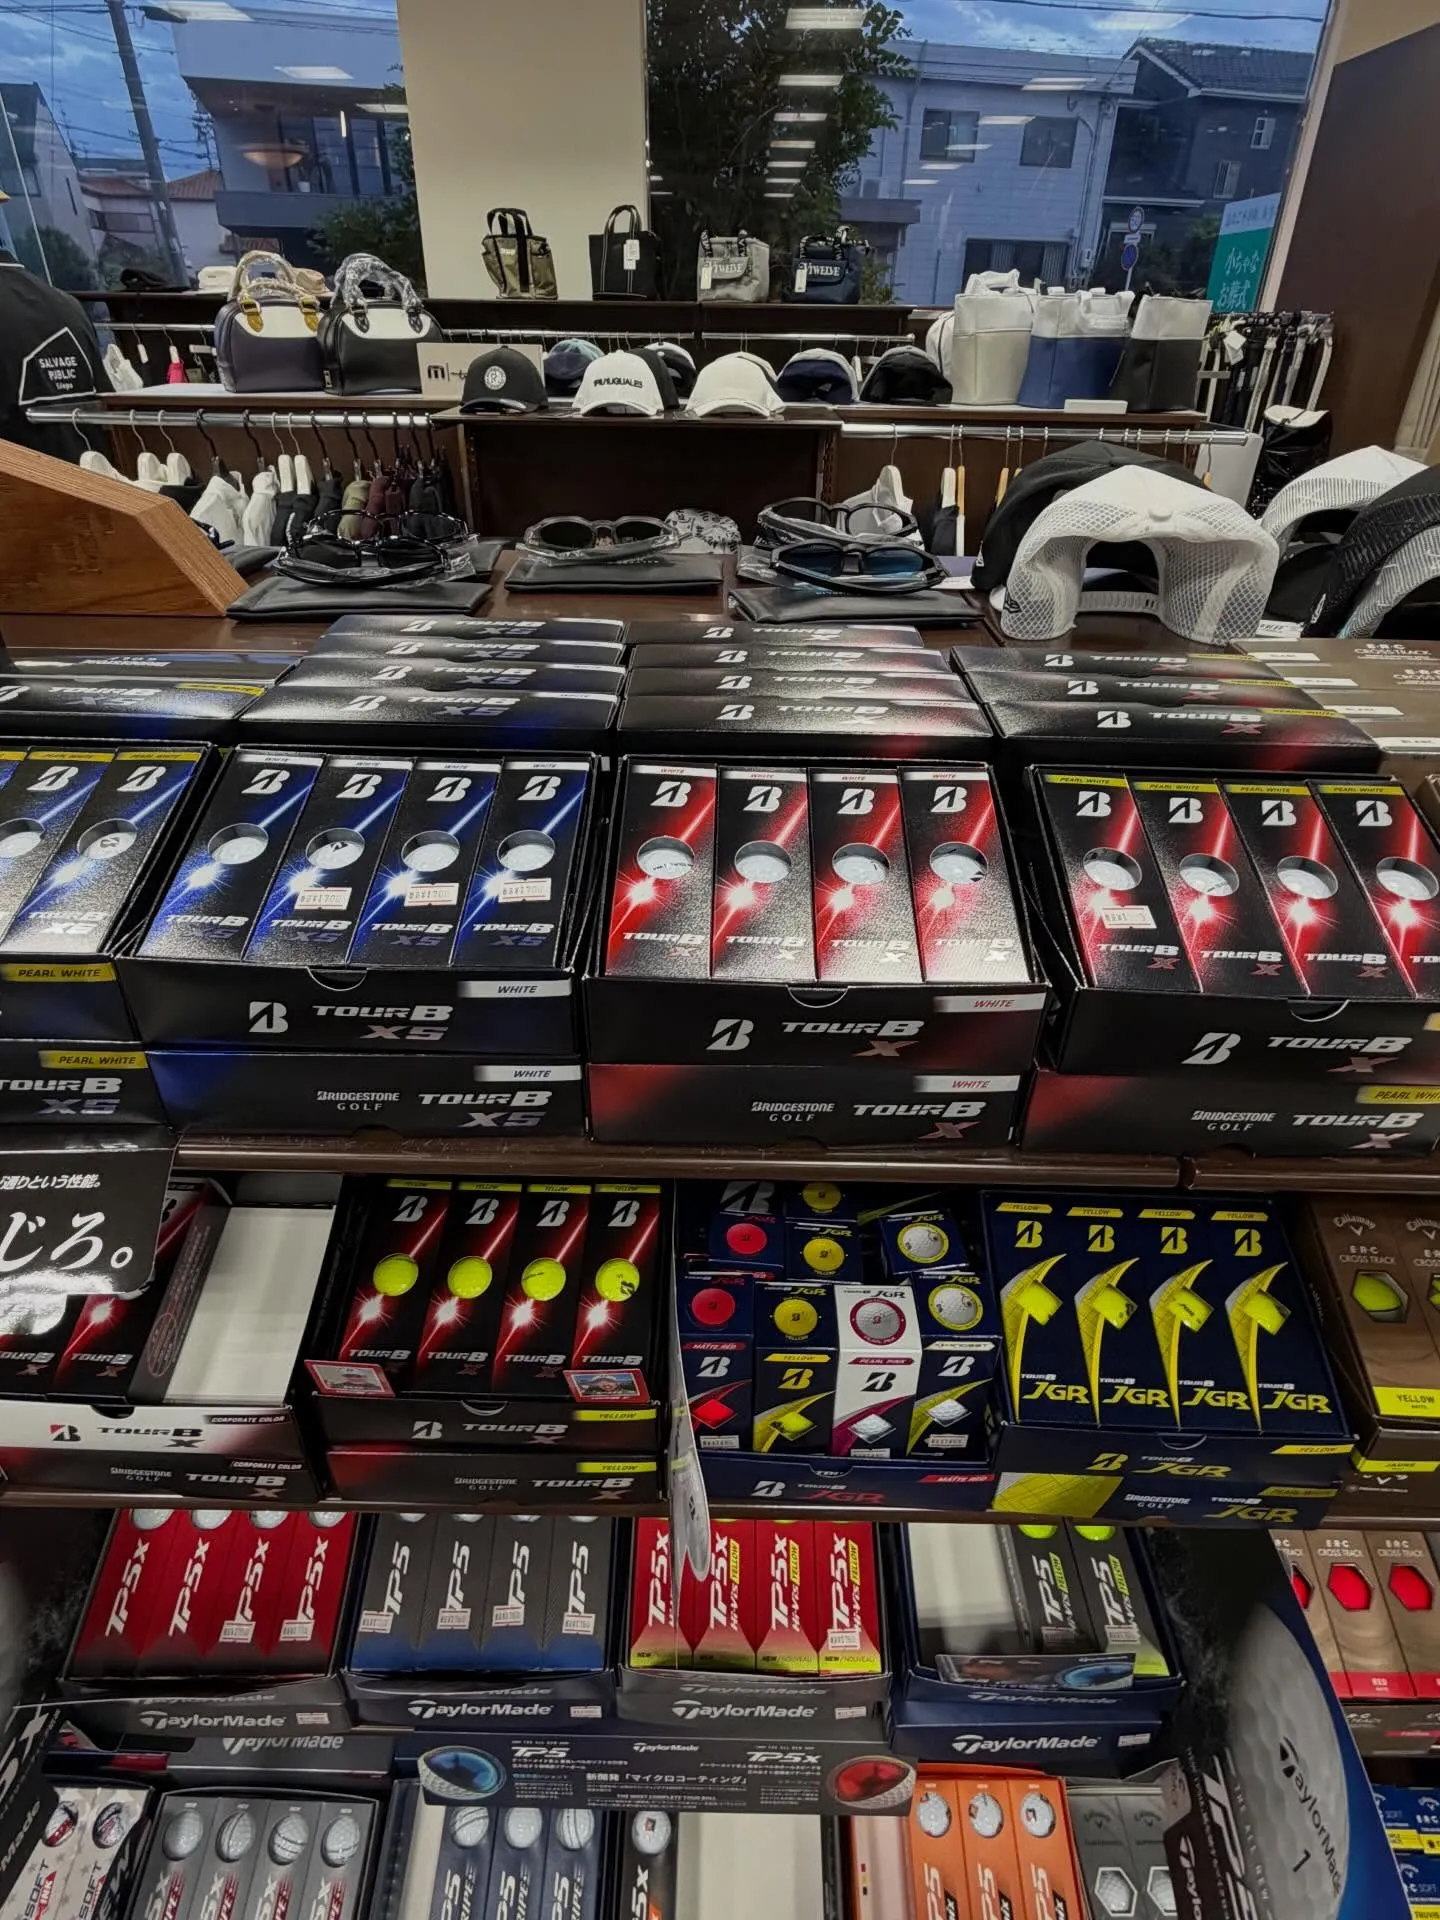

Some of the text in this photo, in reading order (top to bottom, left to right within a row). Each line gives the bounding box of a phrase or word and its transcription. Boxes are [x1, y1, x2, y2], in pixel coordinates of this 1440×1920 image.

[39, 357, 78, 369] SALVAGE
[48, 369, 76, 381] PUBLIC
[18, 968, 101, 978] PEARL WHITE
[497, 984, 537, 994] WHITE
[973, 999, 1015, 1009] WHITE
[59, 1055, 137, 1065] PEARL WHITE
[513, 1069, 551, 1078] WHITE
[951, 1079, 991, 1089] WHITE
[317, 1090, 400, 1101] BRIDGESTONE
[1375, 1091, 1410, 1100] PEARL
[337, 1102, 383, 1111] GOLF
[751, 1101, 835, 1113] BRIDGESTONE
[769, 1113, 816, 1122] GOLF
[1191, 1111, 1276, 1121] BRIDGESTONE
[1207, 1122, 1254, 1131] GOLF
[1023, 1382, 1091, 1404] JGR
[1102, 1386, 1171, 1408] JGR
[1182, 1388, 1251, 1410] JGR
[1396, 1394, 1435, 1404] YELLOW
[1262, 1391, 1333, 1413] JGR
[211, 1416, 257, 1424] CORPORATE
[232, 1461, 303, 1471] CORPORATE COLOR
[1131, 1462, 1232, 1478] JGR
[1202, 1505, 1298, 1523] JGR
[731, 1543, 739, 1582] YELLOW
[791, 1544, 799, 1584] YELLOW
[850, 1544, 859, 1584] YELLOW
[384, 1541, 411, 1615] TP5
[568, 1541, 589, 1614] TP5
[1032, 1554, 1064, 1624] TP5
[408, 1699, 555, 1719] TaylorMade
[672, 1699, 818, 1720] TaylorMade
[139, 1710, 286, 1729] TaylorMade
[633, 1742, 700, 1753] TaylorMade
[952, 1733, 1102, 1754] TaylorMade
[512, 1746, 571, 1758] TP5
